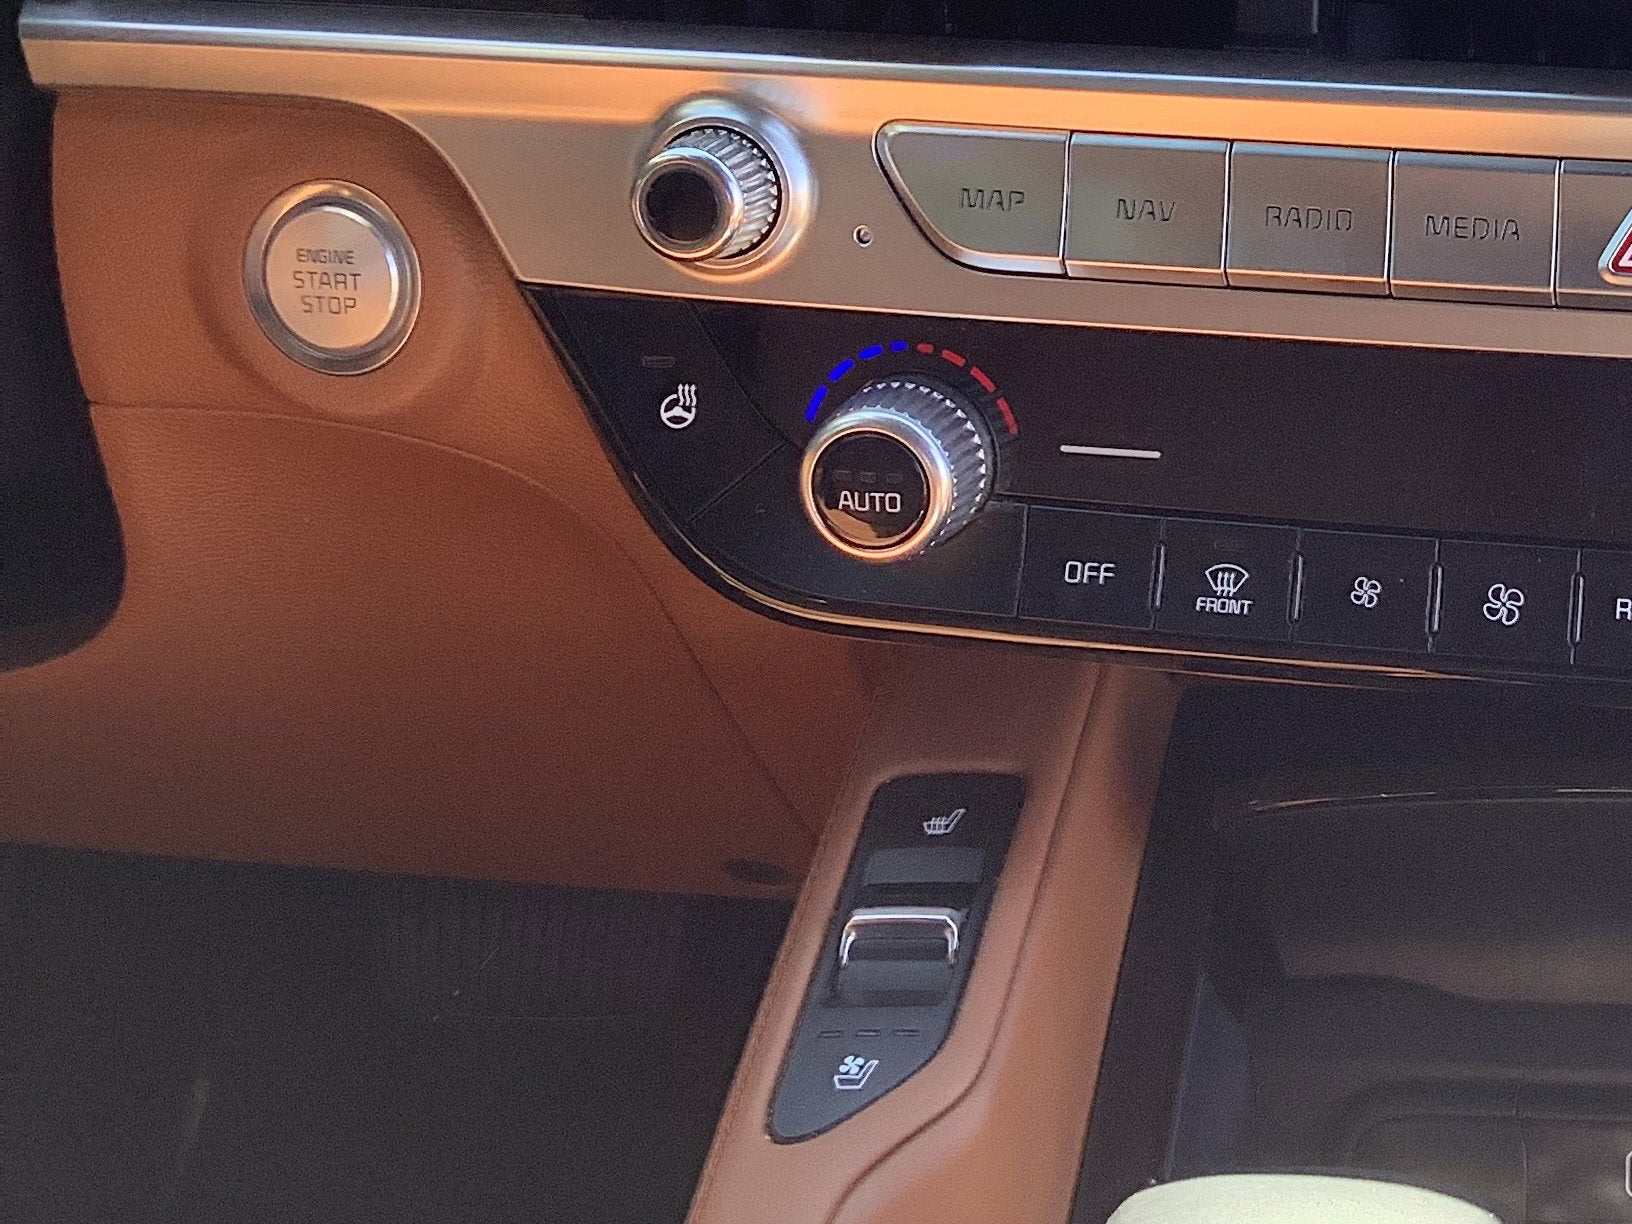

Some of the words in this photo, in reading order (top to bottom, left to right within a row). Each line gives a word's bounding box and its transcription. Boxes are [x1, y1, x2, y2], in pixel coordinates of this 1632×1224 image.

[960, 187, 1026, 213] MAP
[1116, 197, 1177, 223] NAV
[1264, 205, 1353, 231] RADIO
[1424, 215, 1520, 242] MEDIA
[296, 248, 355, 265] ENGINE
[293, 270, 362, 291] START
[301, 295, 357, 315] STOP
[838, 490, 902, 514] AUTO
[1063, 560, 1116, 586] OFF
[1195, 596, 1253, 617] FRONT
